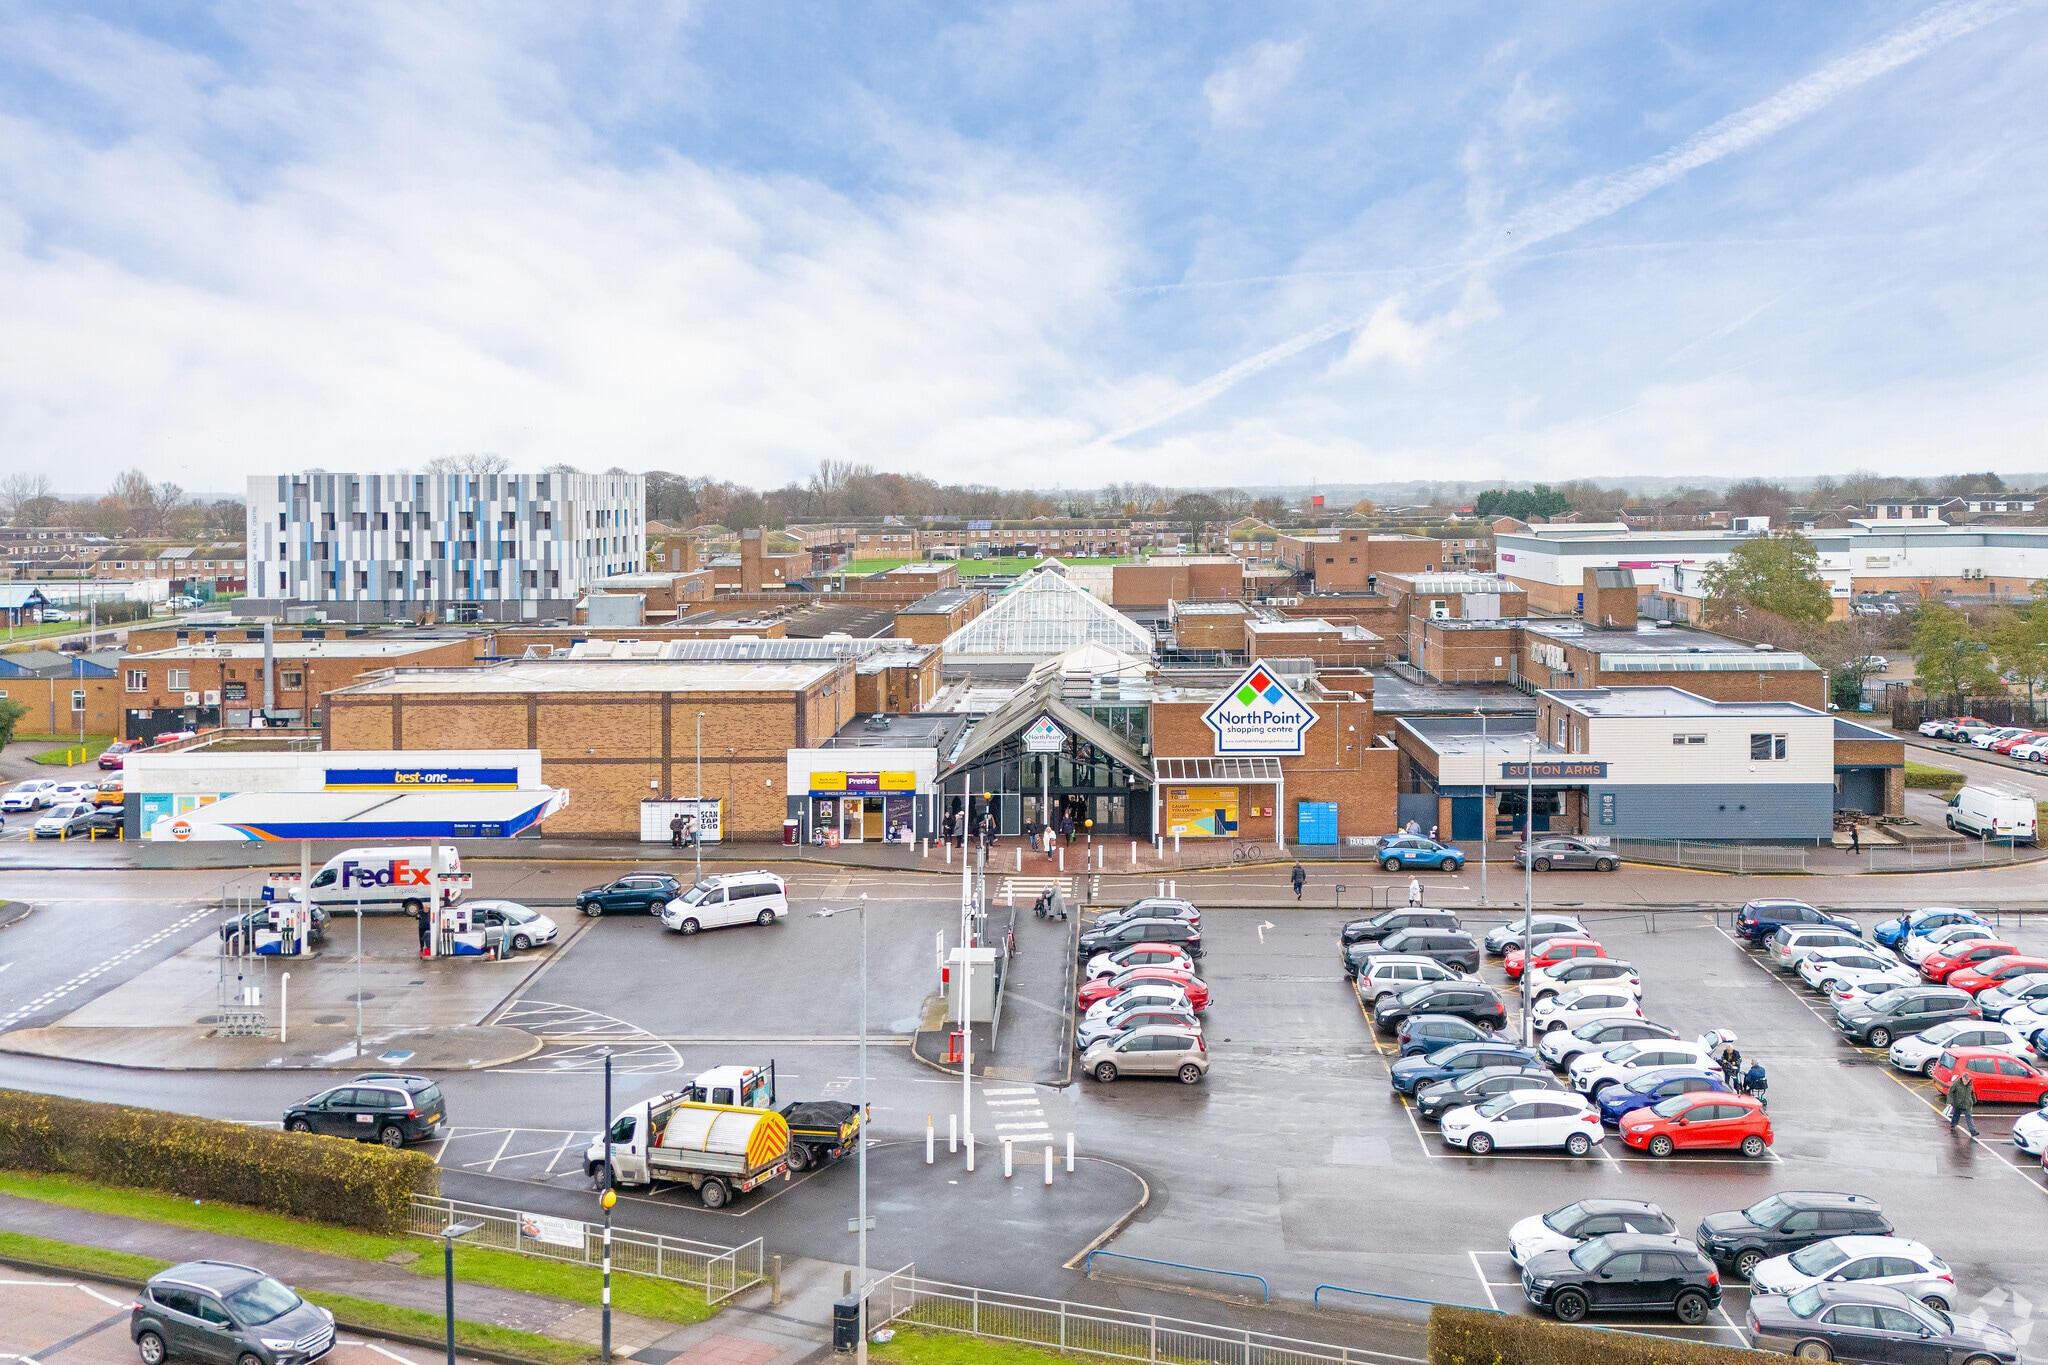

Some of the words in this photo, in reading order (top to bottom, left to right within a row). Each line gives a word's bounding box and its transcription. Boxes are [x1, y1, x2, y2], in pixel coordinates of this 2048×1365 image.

[1227, 726, 1264, 734] shopping
[1565, 765, 1600, 775] ARMS
[395, 771, 448, 783] best-one
[701, 810, 718, 818] SCAN
[1349, 838, 1363, 846] TAXI
[1364, 838, 1377, 846] ONLY
[343, 859, 431, 888] FedEx
